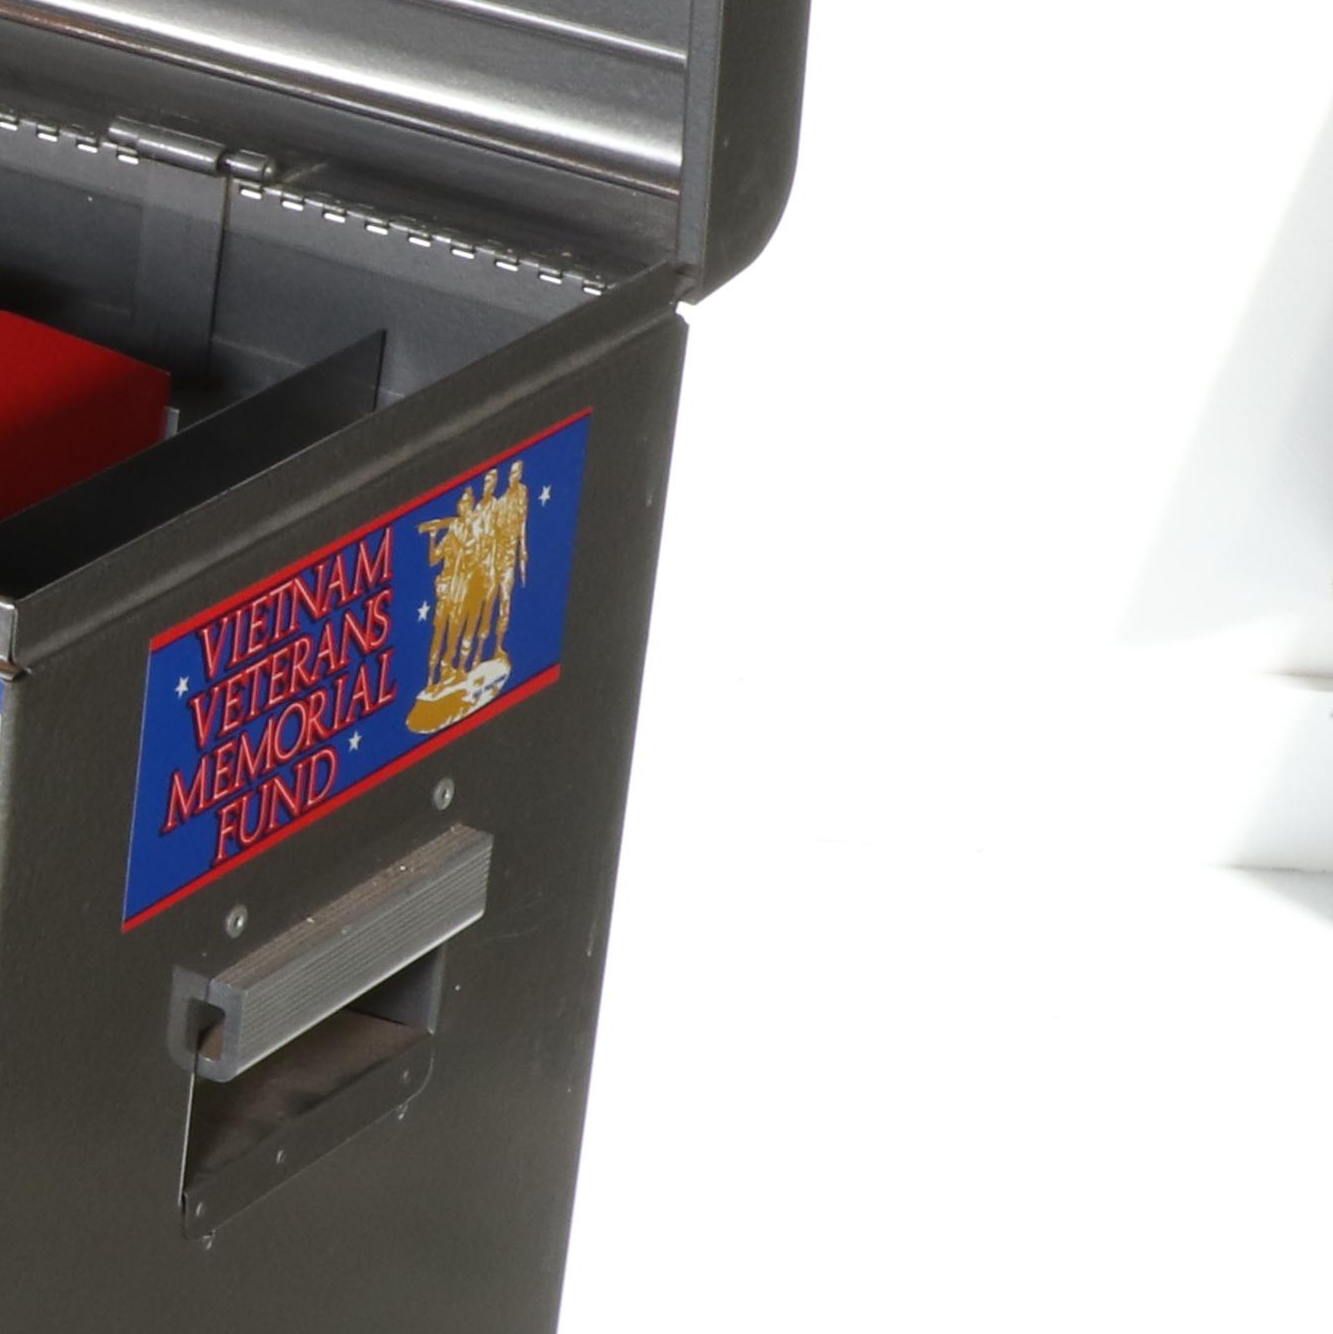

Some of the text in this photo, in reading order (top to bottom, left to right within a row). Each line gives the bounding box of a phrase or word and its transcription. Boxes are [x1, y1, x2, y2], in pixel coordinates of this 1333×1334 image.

[188, 587, 394, 748] VETERANS
[197, 525, 393, 678] VIETNAM
[162, 648, 397, 834] MEMORIAL
[213, 748, 338, 866] FUND
